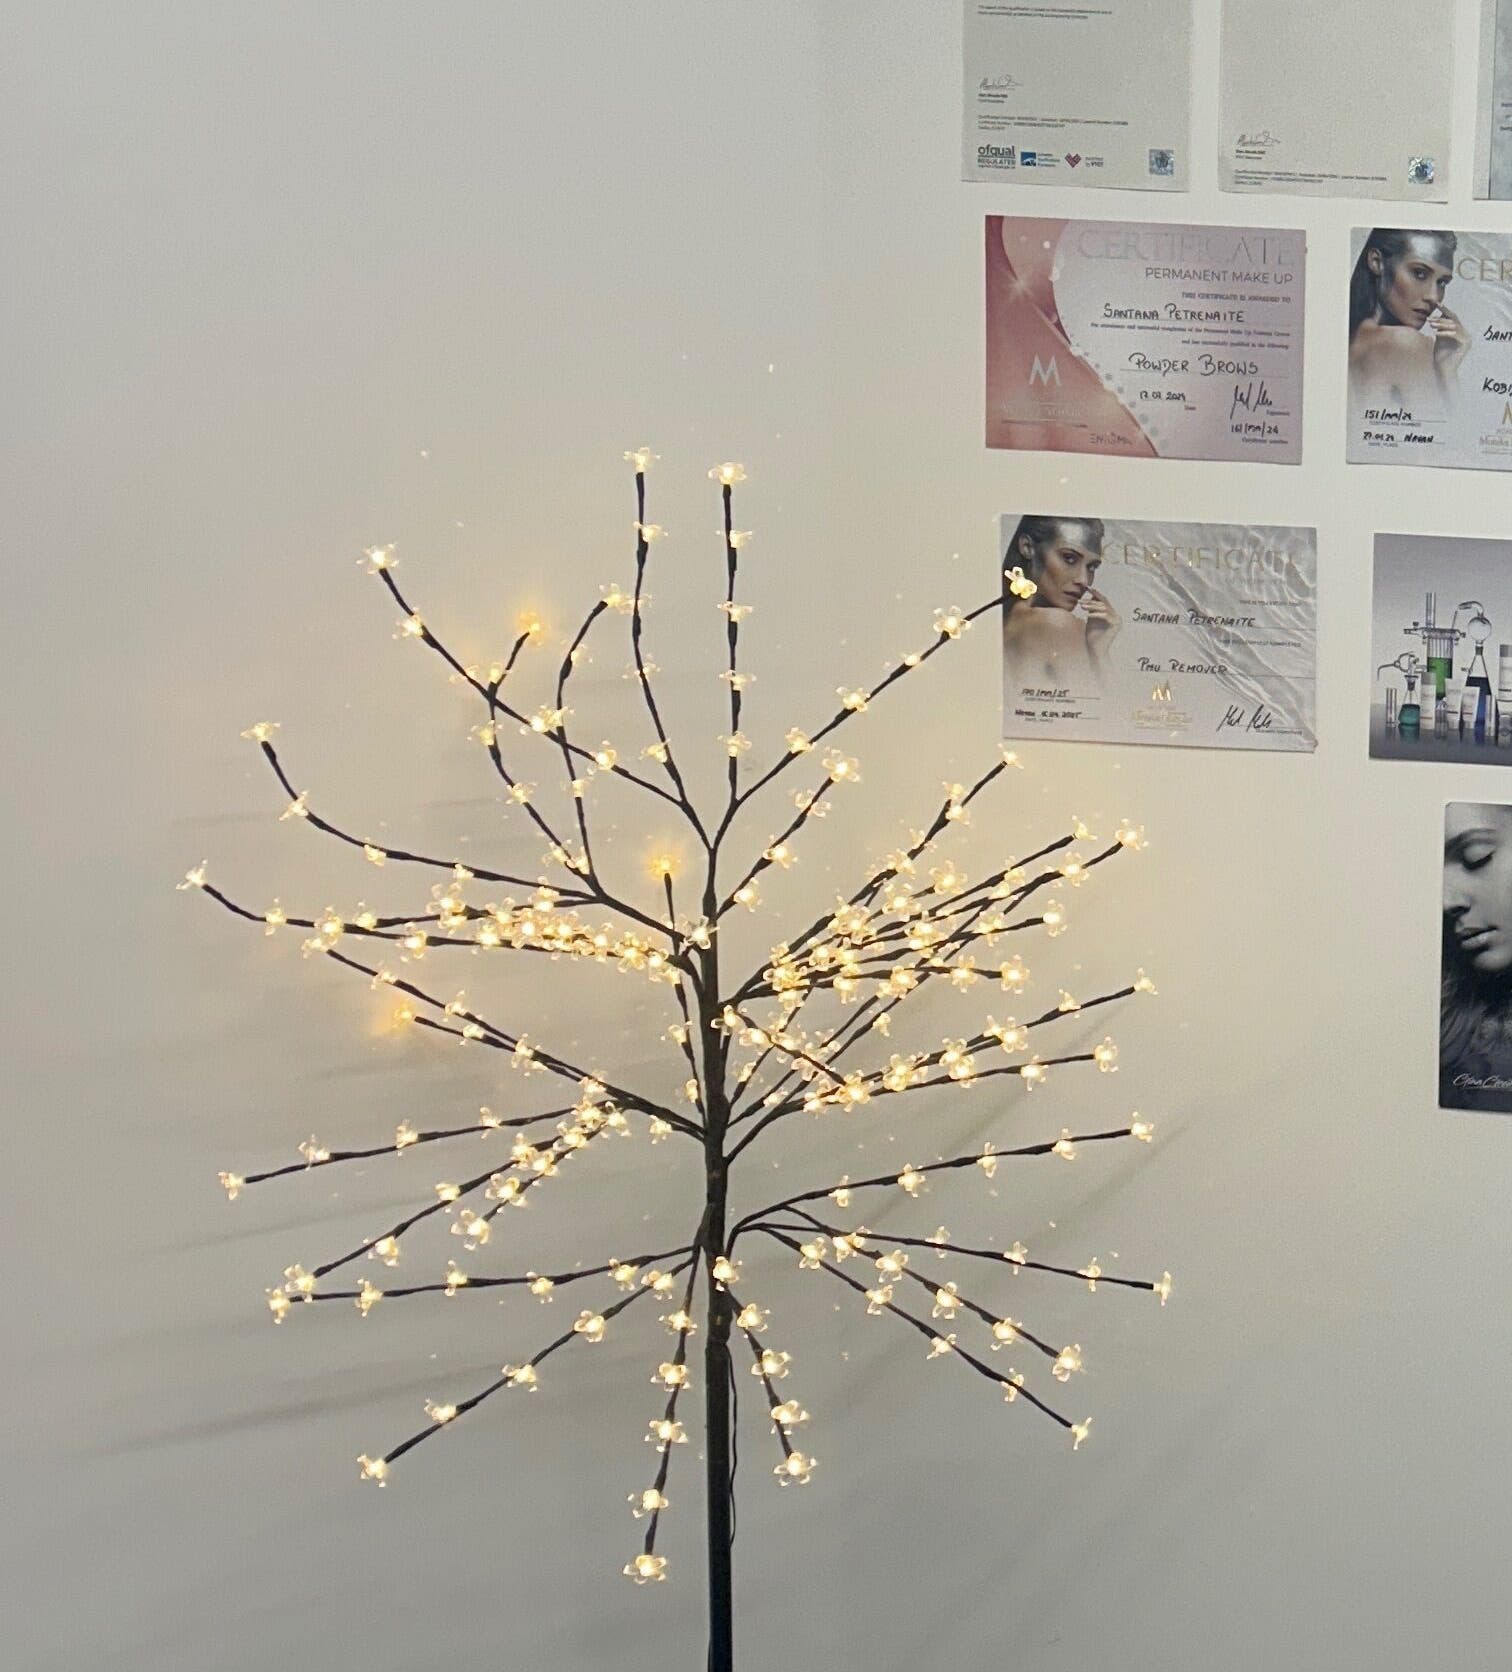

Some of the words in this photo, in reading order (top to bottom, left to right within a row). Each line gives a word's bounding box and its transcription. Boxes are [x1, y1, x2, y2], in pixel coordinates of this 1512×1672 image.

[978, 144, 1015, 157] ofqual
[1145, 267, 1228, 283] PERMANENT
[1232, 270, 1269, 285] MAKE
[1274, 273, 1294, 286] UP
